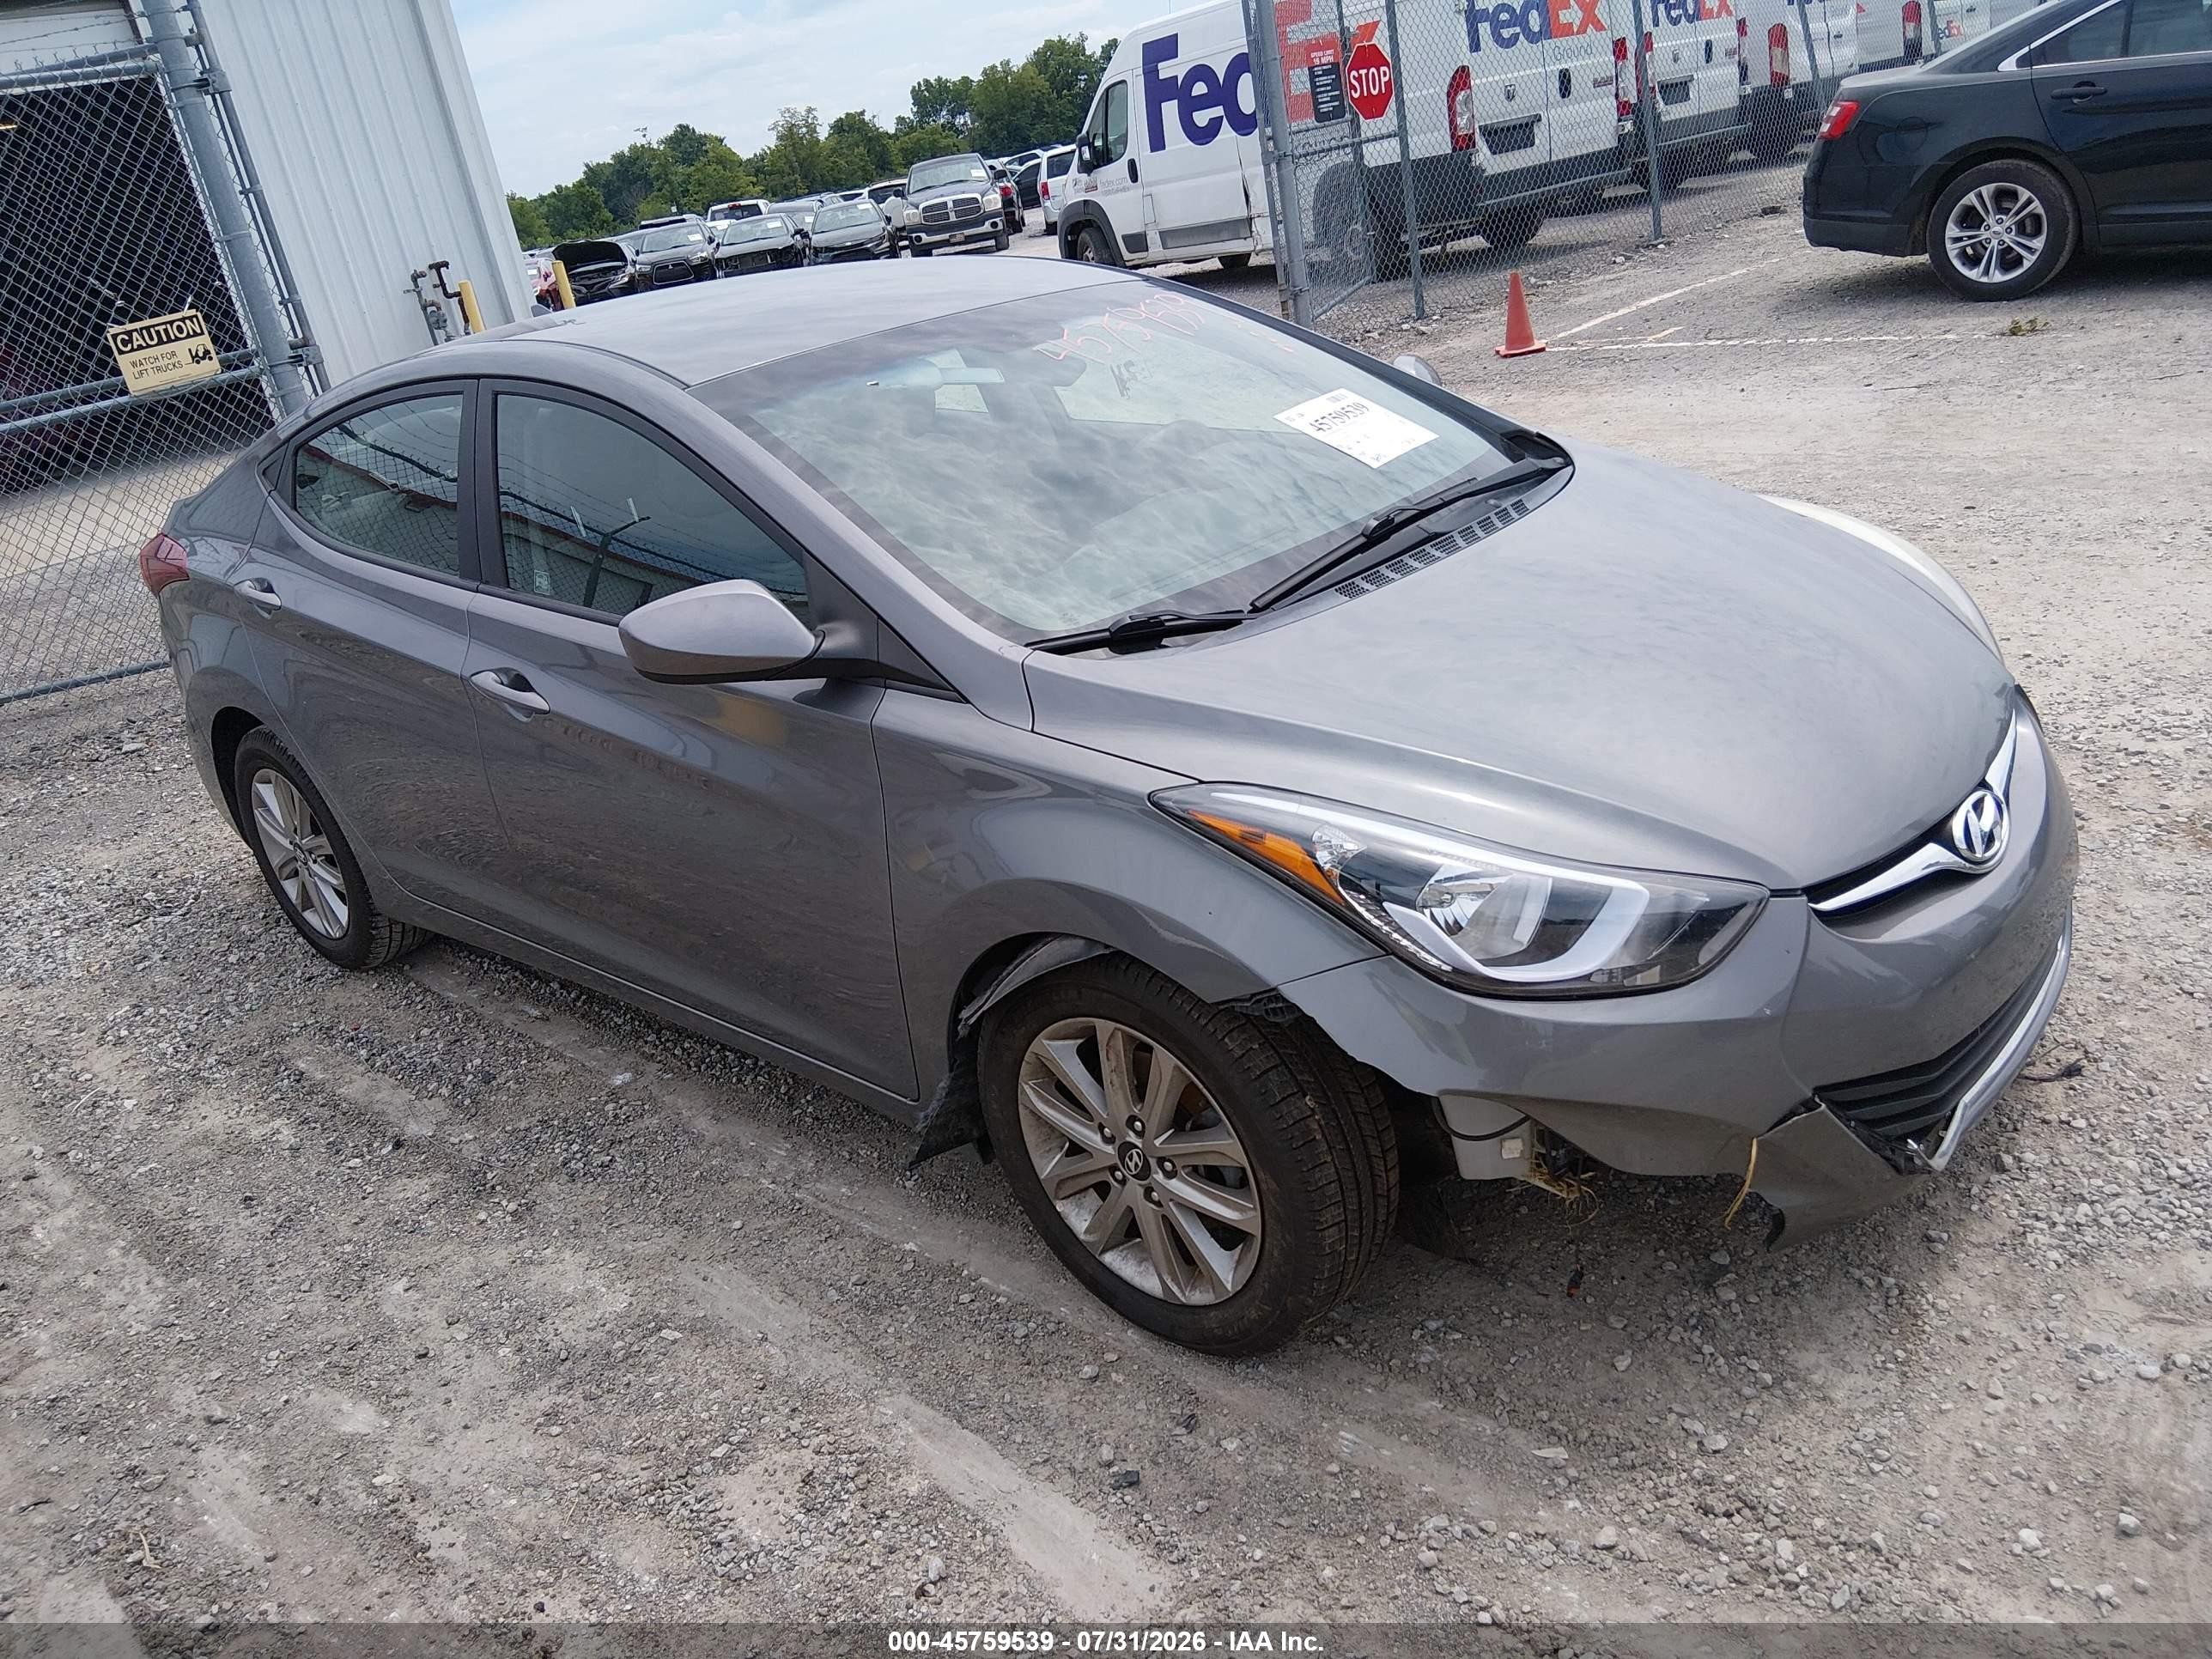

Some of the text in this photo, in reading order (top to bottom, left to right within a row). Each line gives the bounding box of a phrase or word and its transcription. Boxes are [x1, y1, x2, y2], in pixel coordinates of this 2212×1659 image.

[1937, 19, 1963, 40] edEx
[1321, 55, 1334, 64] MPH
[1553, 41, 1593, 61] Ground
[1350, 66, 1389, 99] STOP
[116, 317, 203, 352] CAUTION
[130, 350, 179, 369] WATCH FOR
[133, 361, 184, 380] LIFT TRUCKS
[1309, 401, 1370, 433] 45759539
